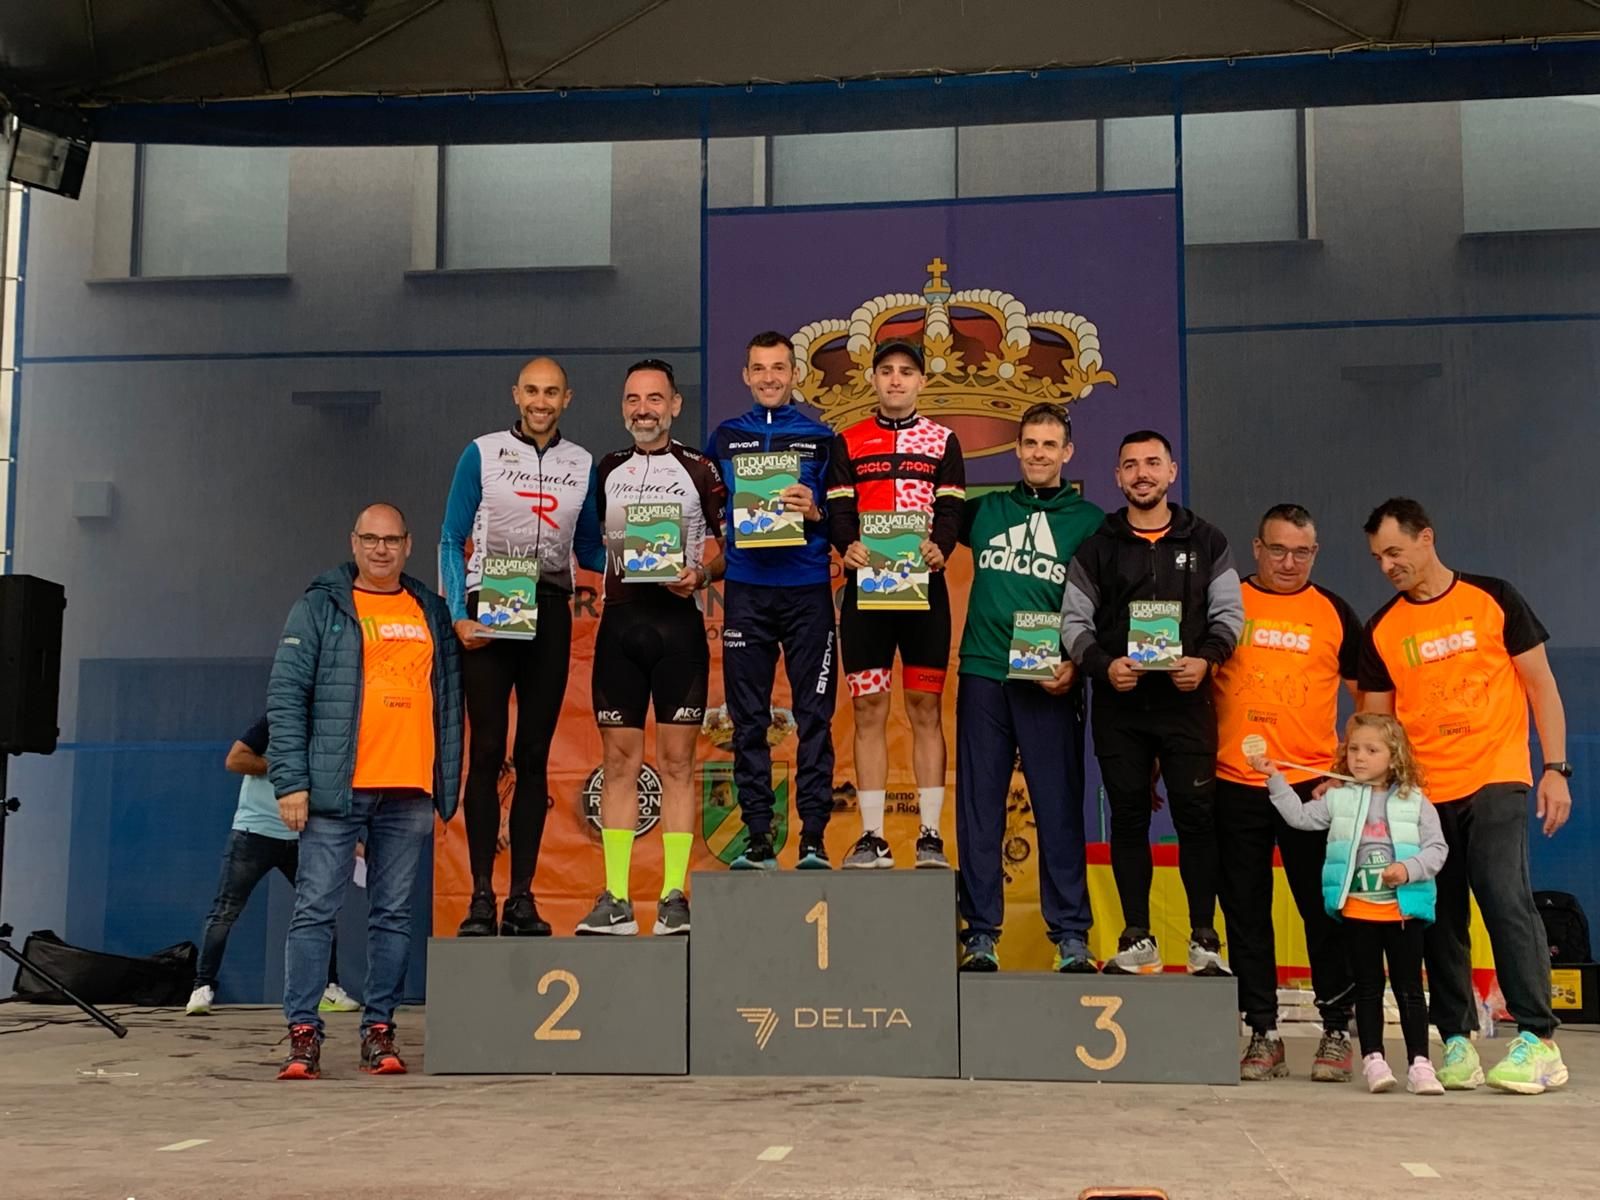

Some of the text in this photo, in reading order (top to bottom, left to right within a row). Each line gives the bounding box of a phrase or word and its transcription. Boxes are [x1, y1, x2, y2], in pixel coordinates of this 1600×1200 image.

[729, 440, 760, 449] GIVOVA
[736, 465, 764, 476] CROS
[856, 461, 936, 475] CICLO SPORT
[496, 468, 579, 488] Mazuela
[607, 481, 688, 499] Mazuela
[627, 513, 651, 522] CROS
[863, 524, 890, 534] CROS
[484, 567, 508, 576] CROS
[978, 545, 1067, 585] adidas
[1132, 609, 1153, 618] CROS
[380, 623, 427, 641] CROS
[1015, 620, 1036, 628] CROS
[1254, 628, 1312, 651] CROS
[1421, 629, 1477, 659] CROS
[816, 630, 834, 694] GIVOVA
[805, 900, 829, 970] 1
[534, 969, 581, 1041] 2
[794, 1007, 912, 1029] DELTA
[1075, 995, 1127, 1071] 3
